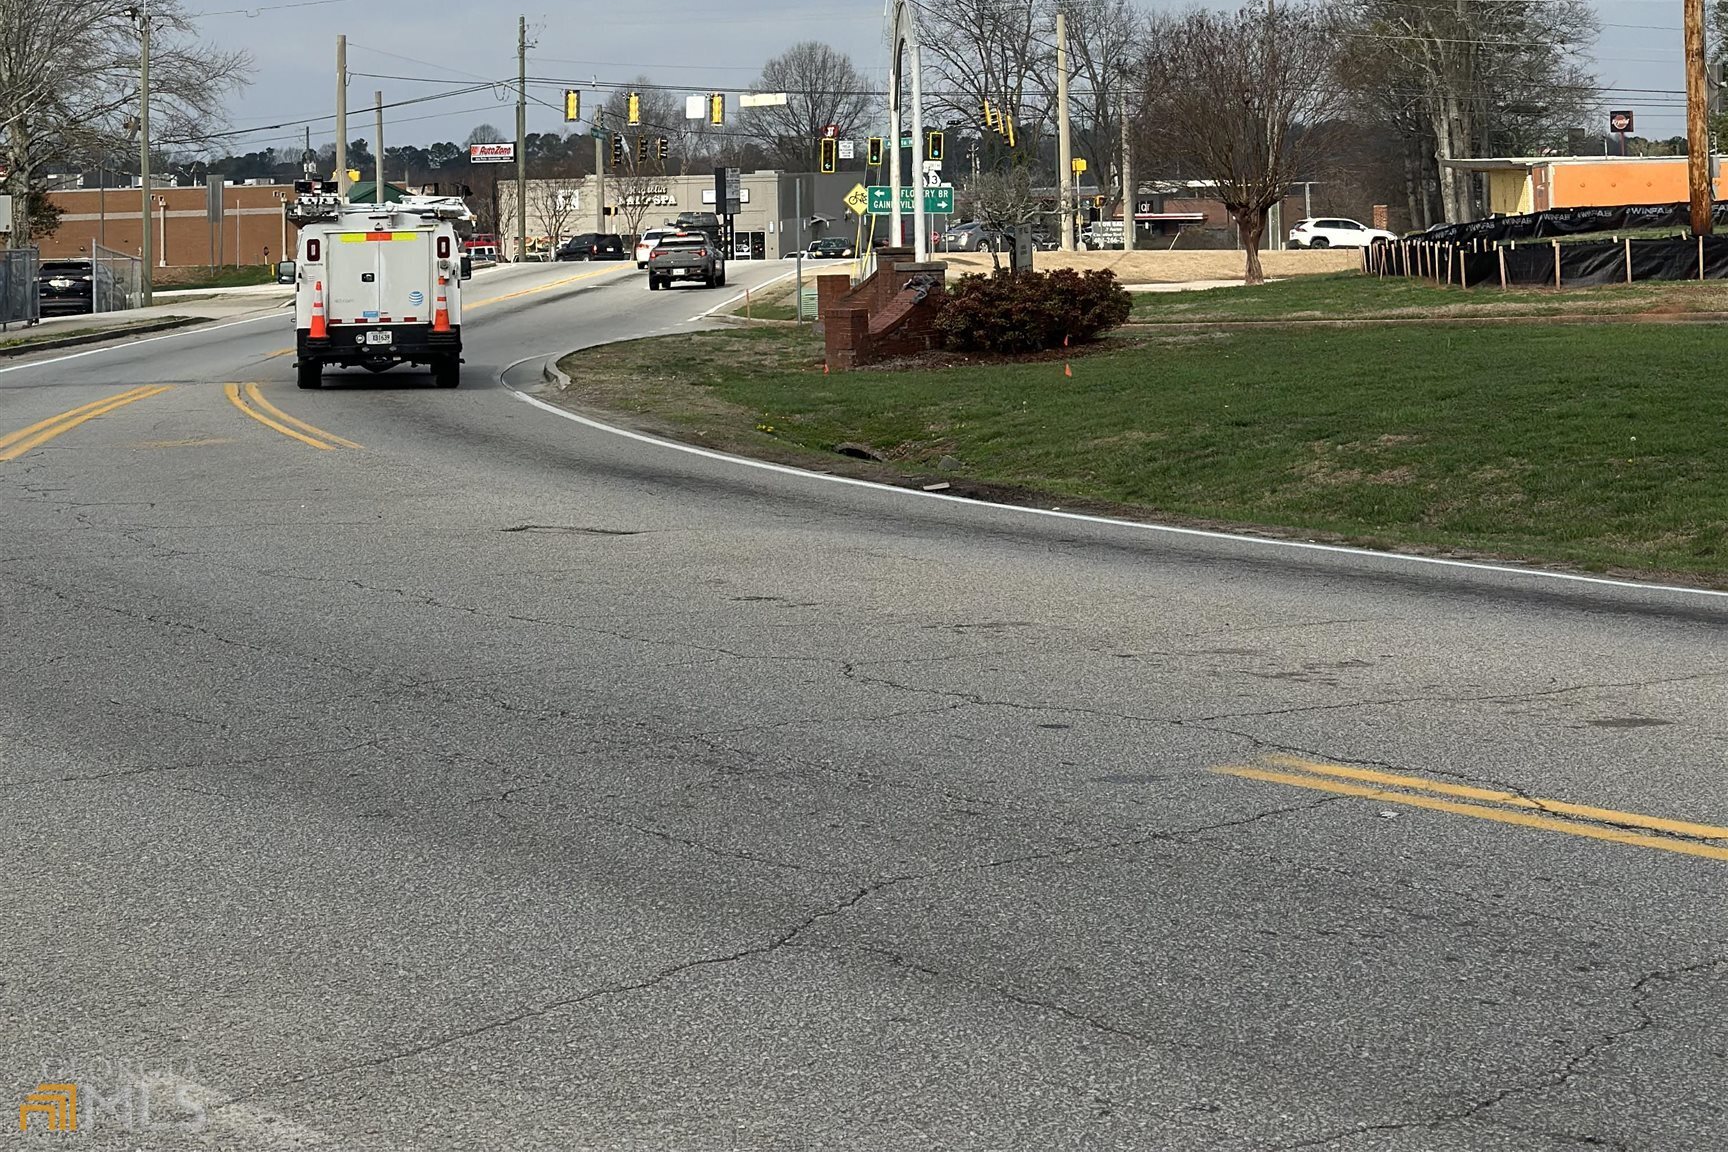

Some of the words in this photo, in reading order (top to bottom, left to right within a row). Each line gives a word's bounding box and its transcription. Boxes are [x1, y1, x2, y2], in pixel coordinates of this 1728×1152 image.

[480, 146, 511, 155] AutoZone
[901, 189, 935, 198] FLORY
[938, 189, 949, 198] BR
[653, 194, 677, 205] SPA
[873, 200, 915, 209] GAINVILL
